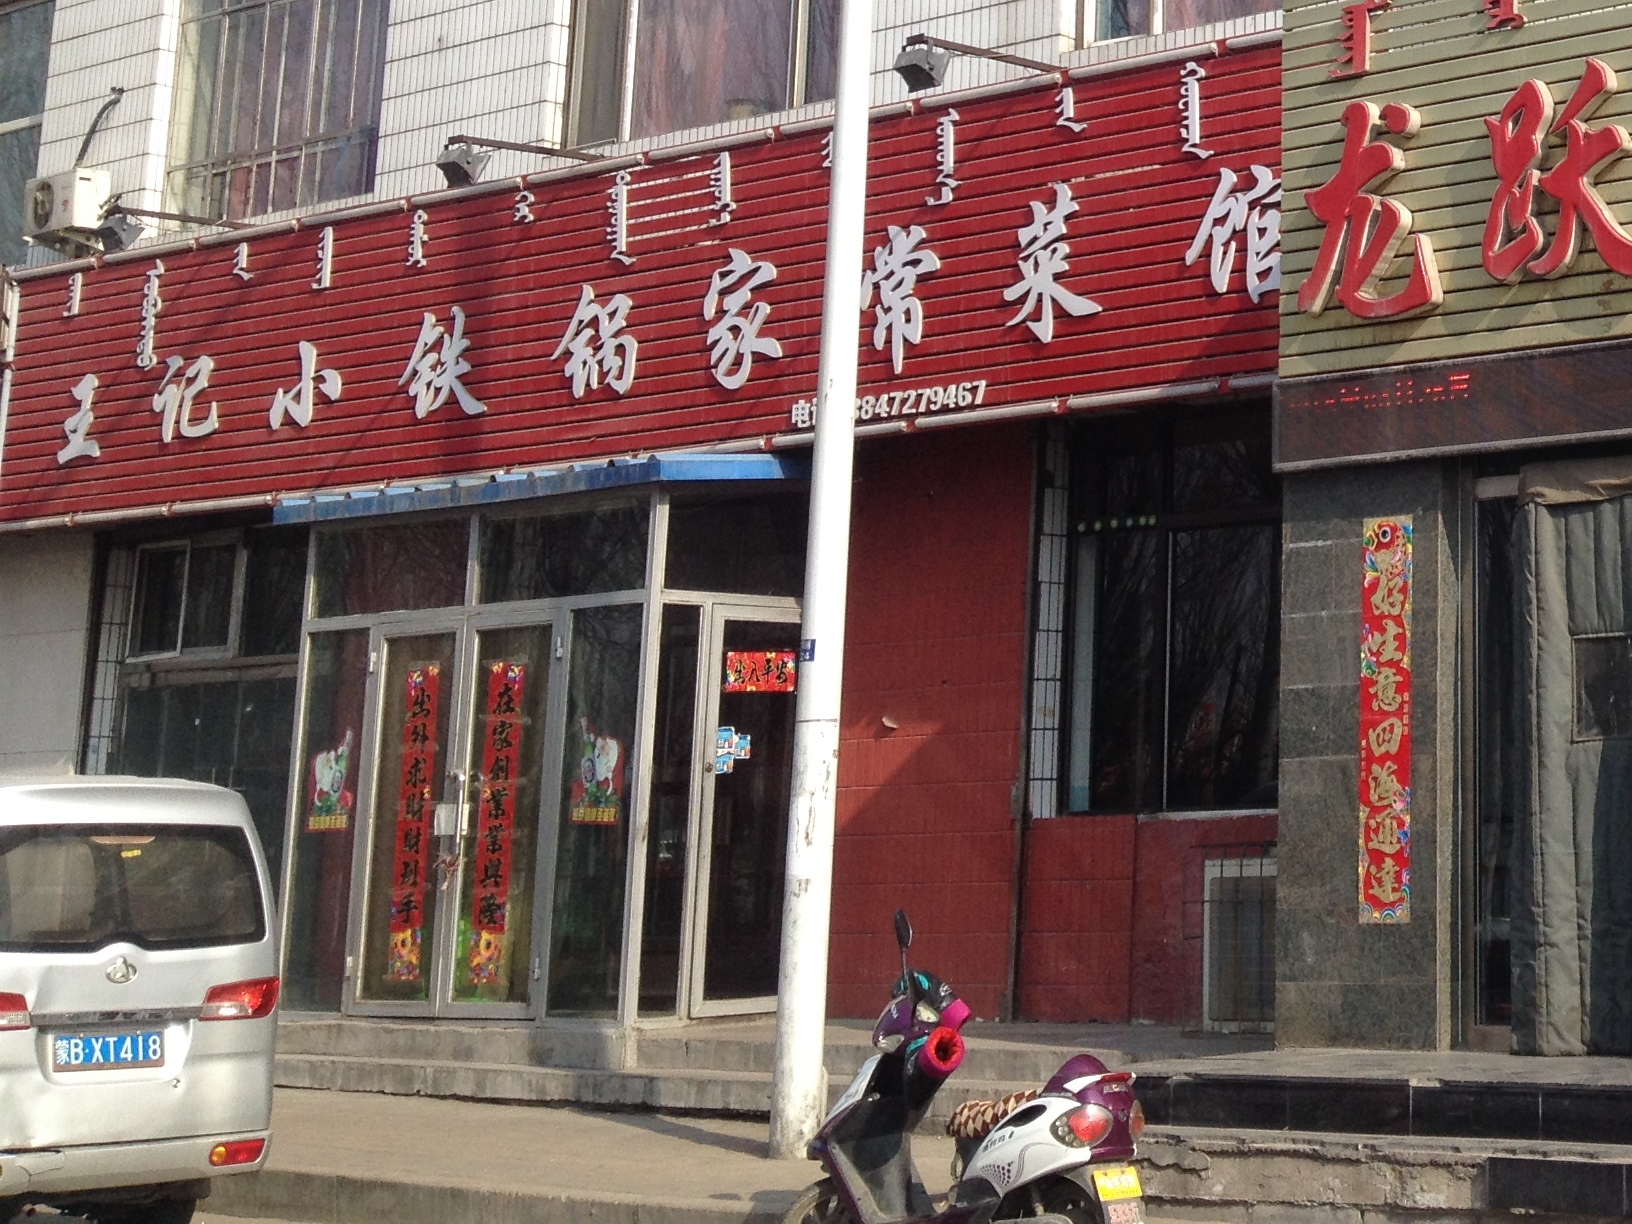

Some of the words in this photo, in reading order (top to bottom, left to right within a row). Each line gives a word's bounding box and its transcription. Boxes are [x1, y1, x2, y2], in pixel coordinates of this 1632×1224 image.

[56, 164, 1283, 465] 王记小铁锅家常菜馆
